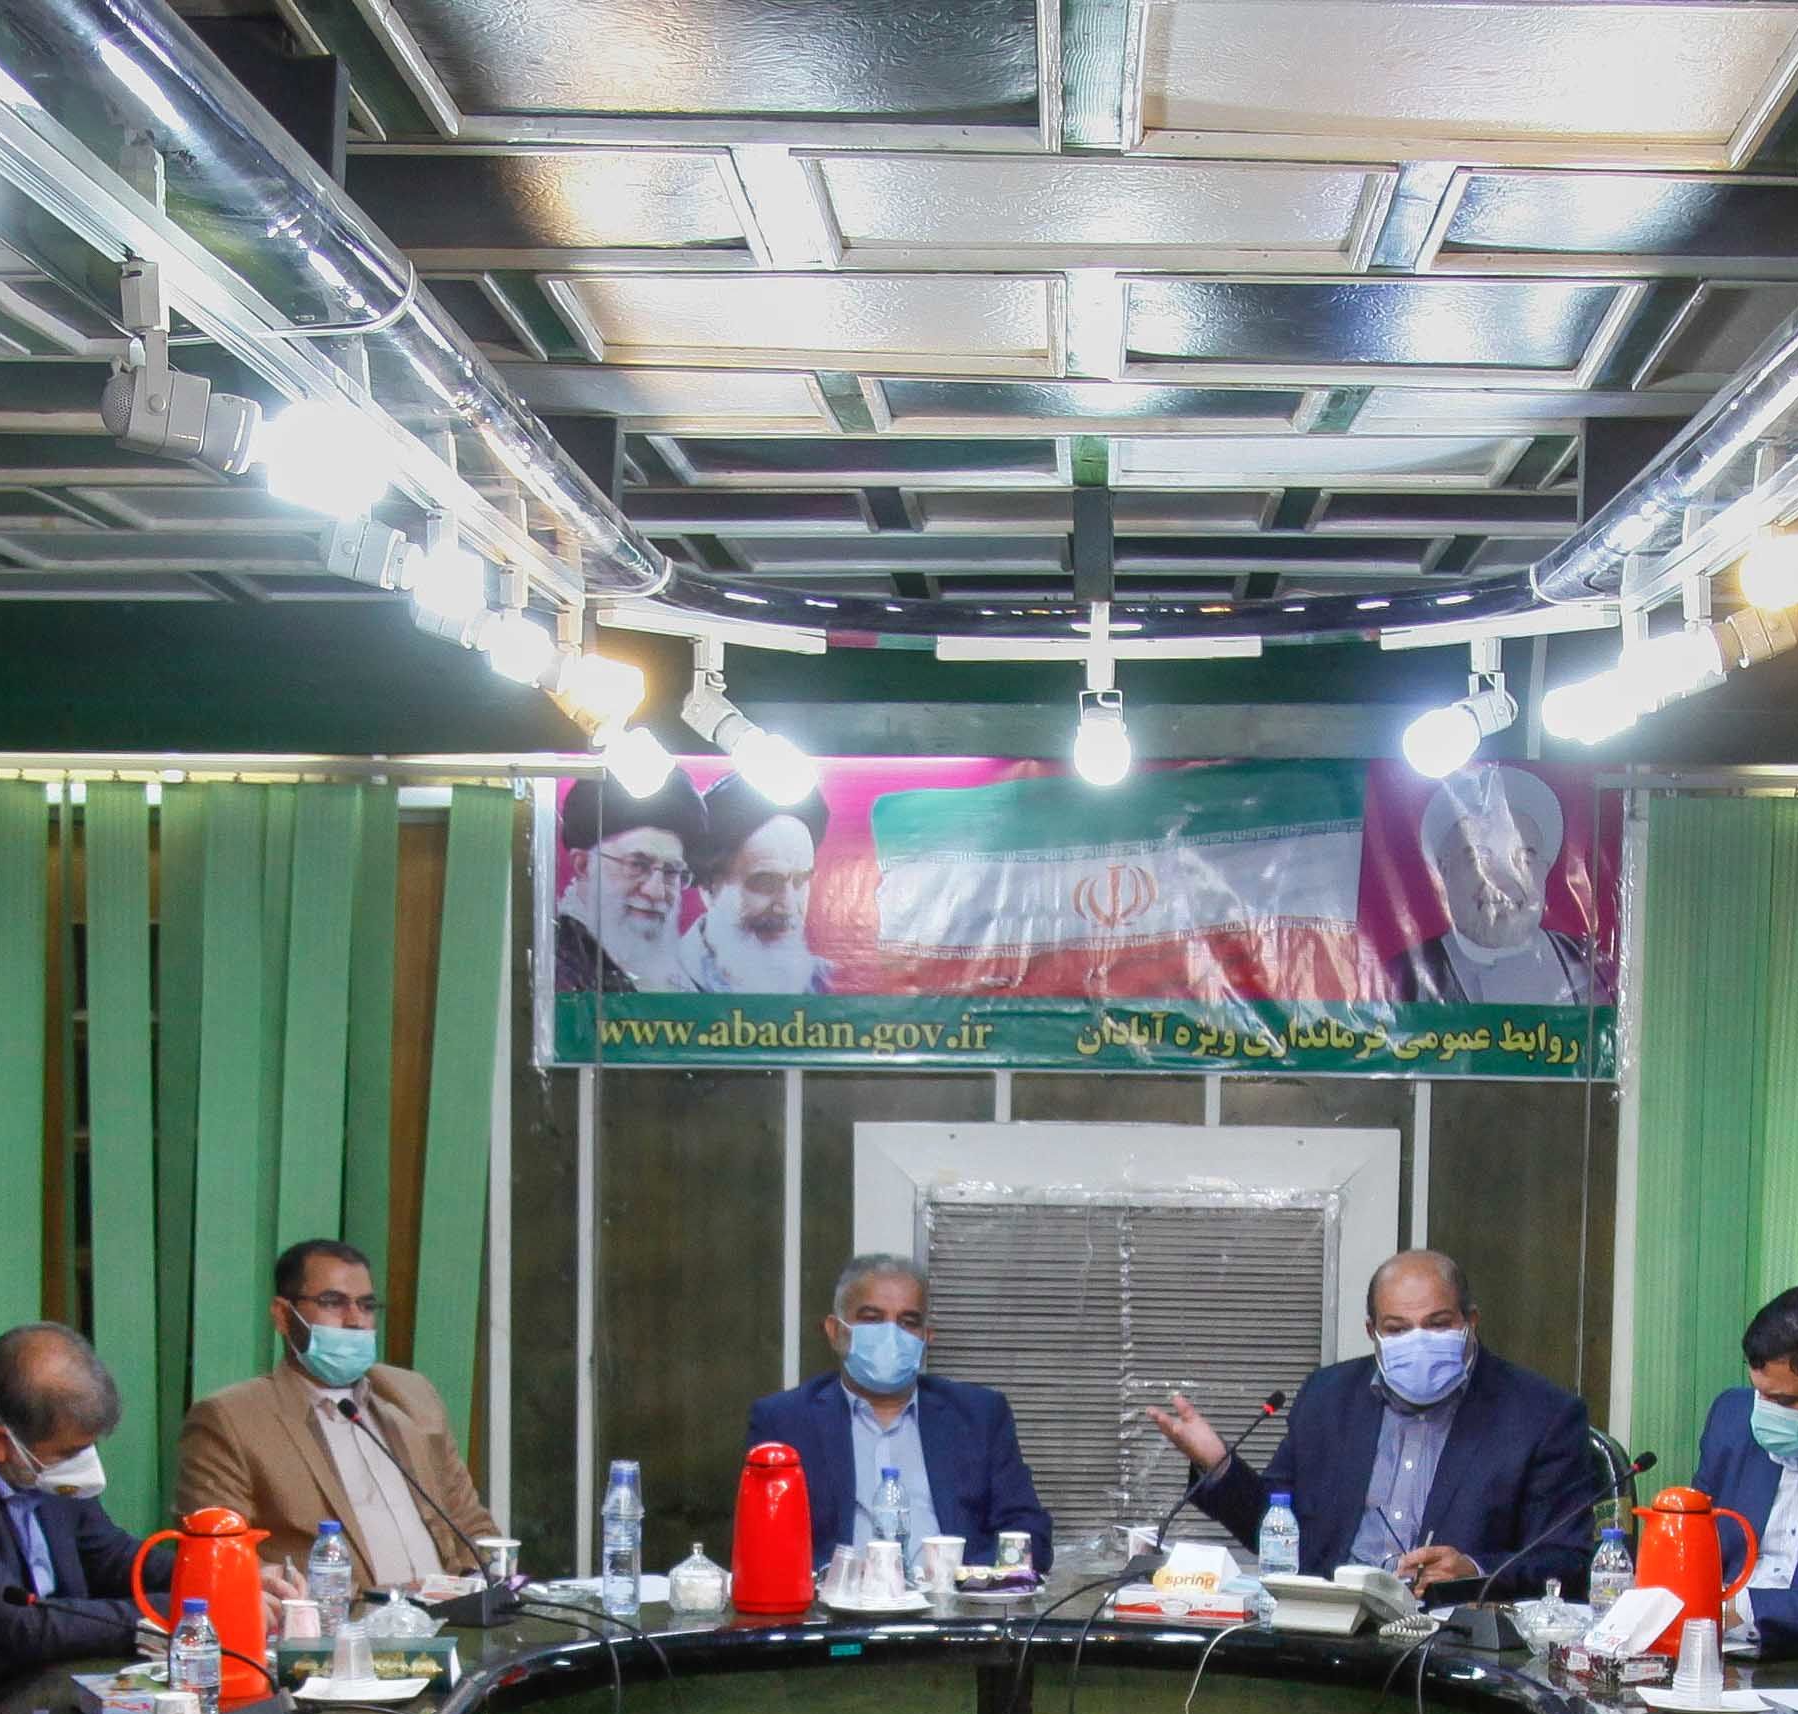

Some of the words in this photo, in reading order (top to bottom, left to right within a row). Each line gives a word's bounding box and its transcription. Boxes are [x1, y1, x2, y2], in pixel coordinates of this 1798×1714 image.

[597, 1009, 994, 1057] www.abadan.gov.ir
[1076, 1010, 1170, 1055] آبادان
[1243, 1015, 1387, 1059] فرمانداری
[1393, 1027, 1491, 1061] عمومی
[1498, 1019, 1580, 1064] روابط
